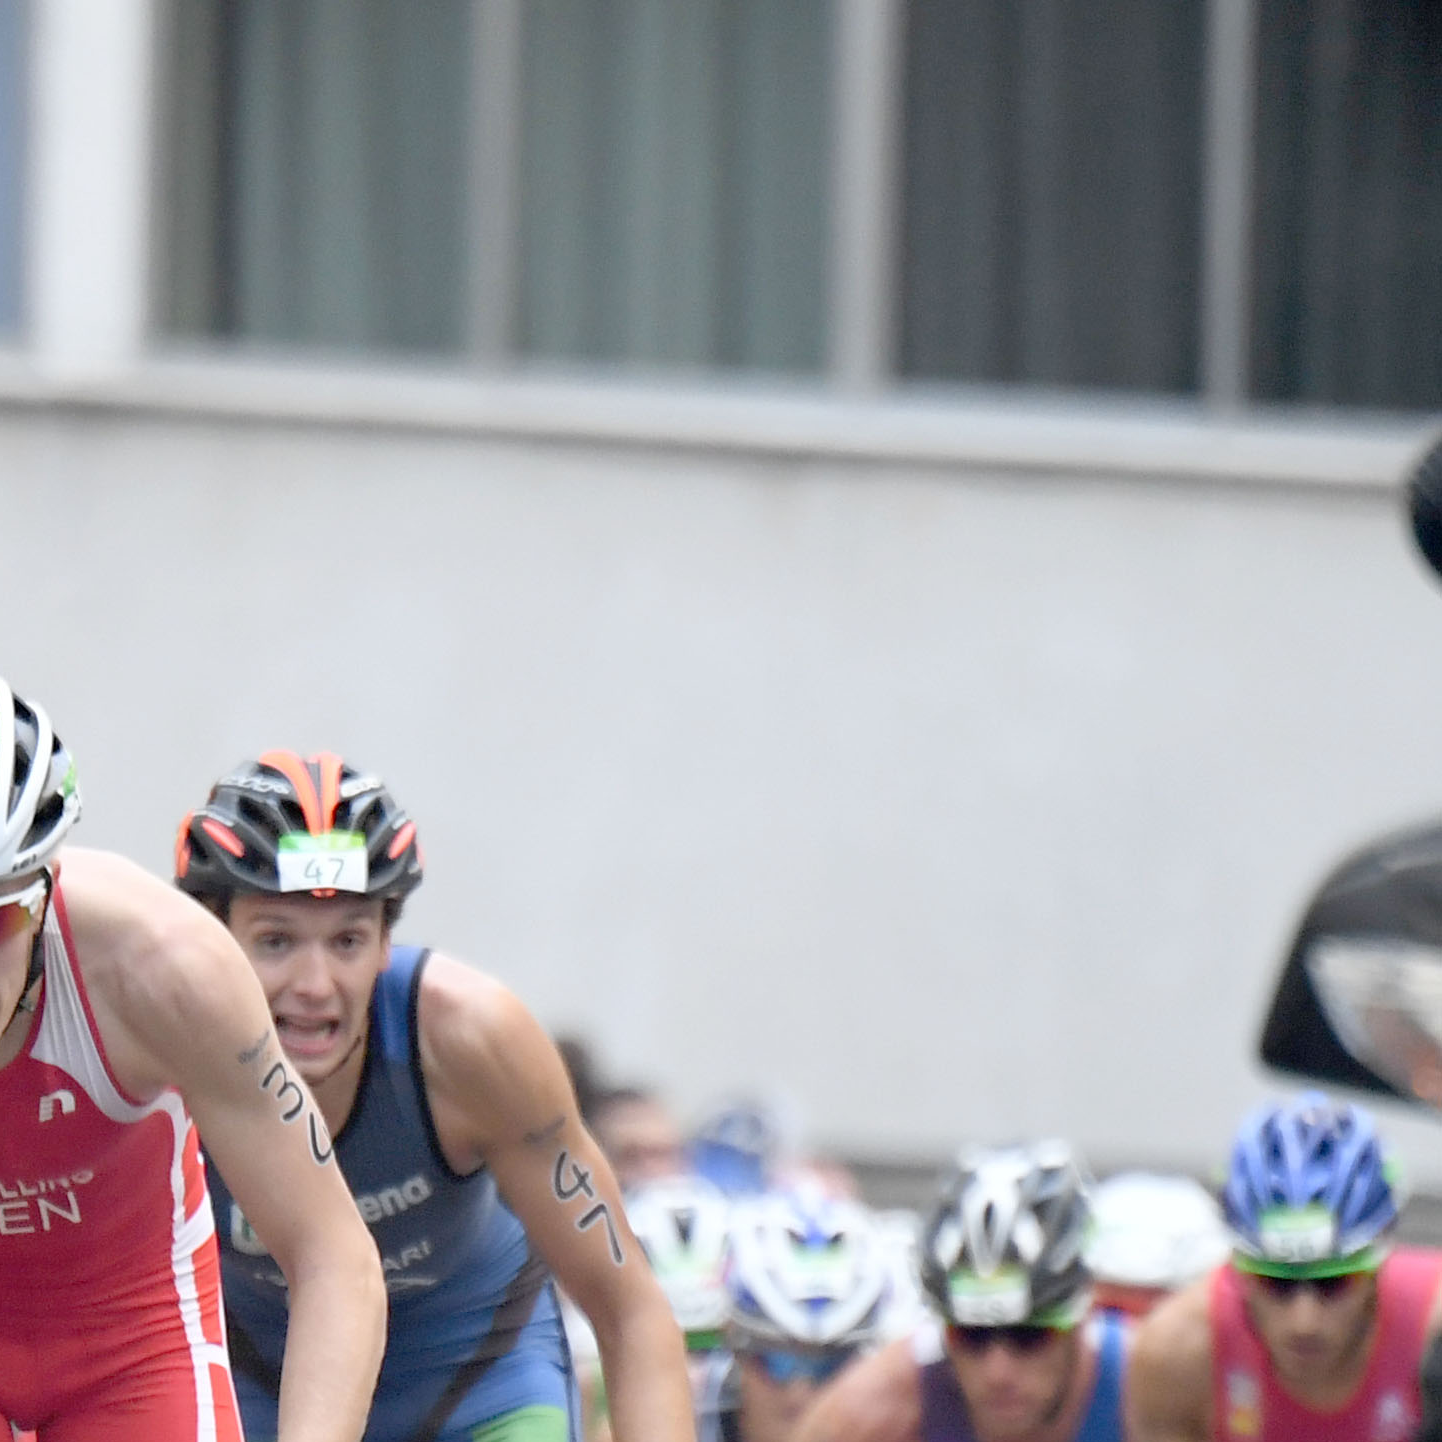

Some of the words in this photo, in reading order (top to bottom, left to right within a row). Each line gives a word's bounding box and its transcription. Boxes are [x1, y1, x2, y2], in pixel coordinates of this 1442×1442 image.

[304, 858, 345, 886] 47
[358, 1176, 433, 1223] ena
[554, 1151, 623, 1264] 47
